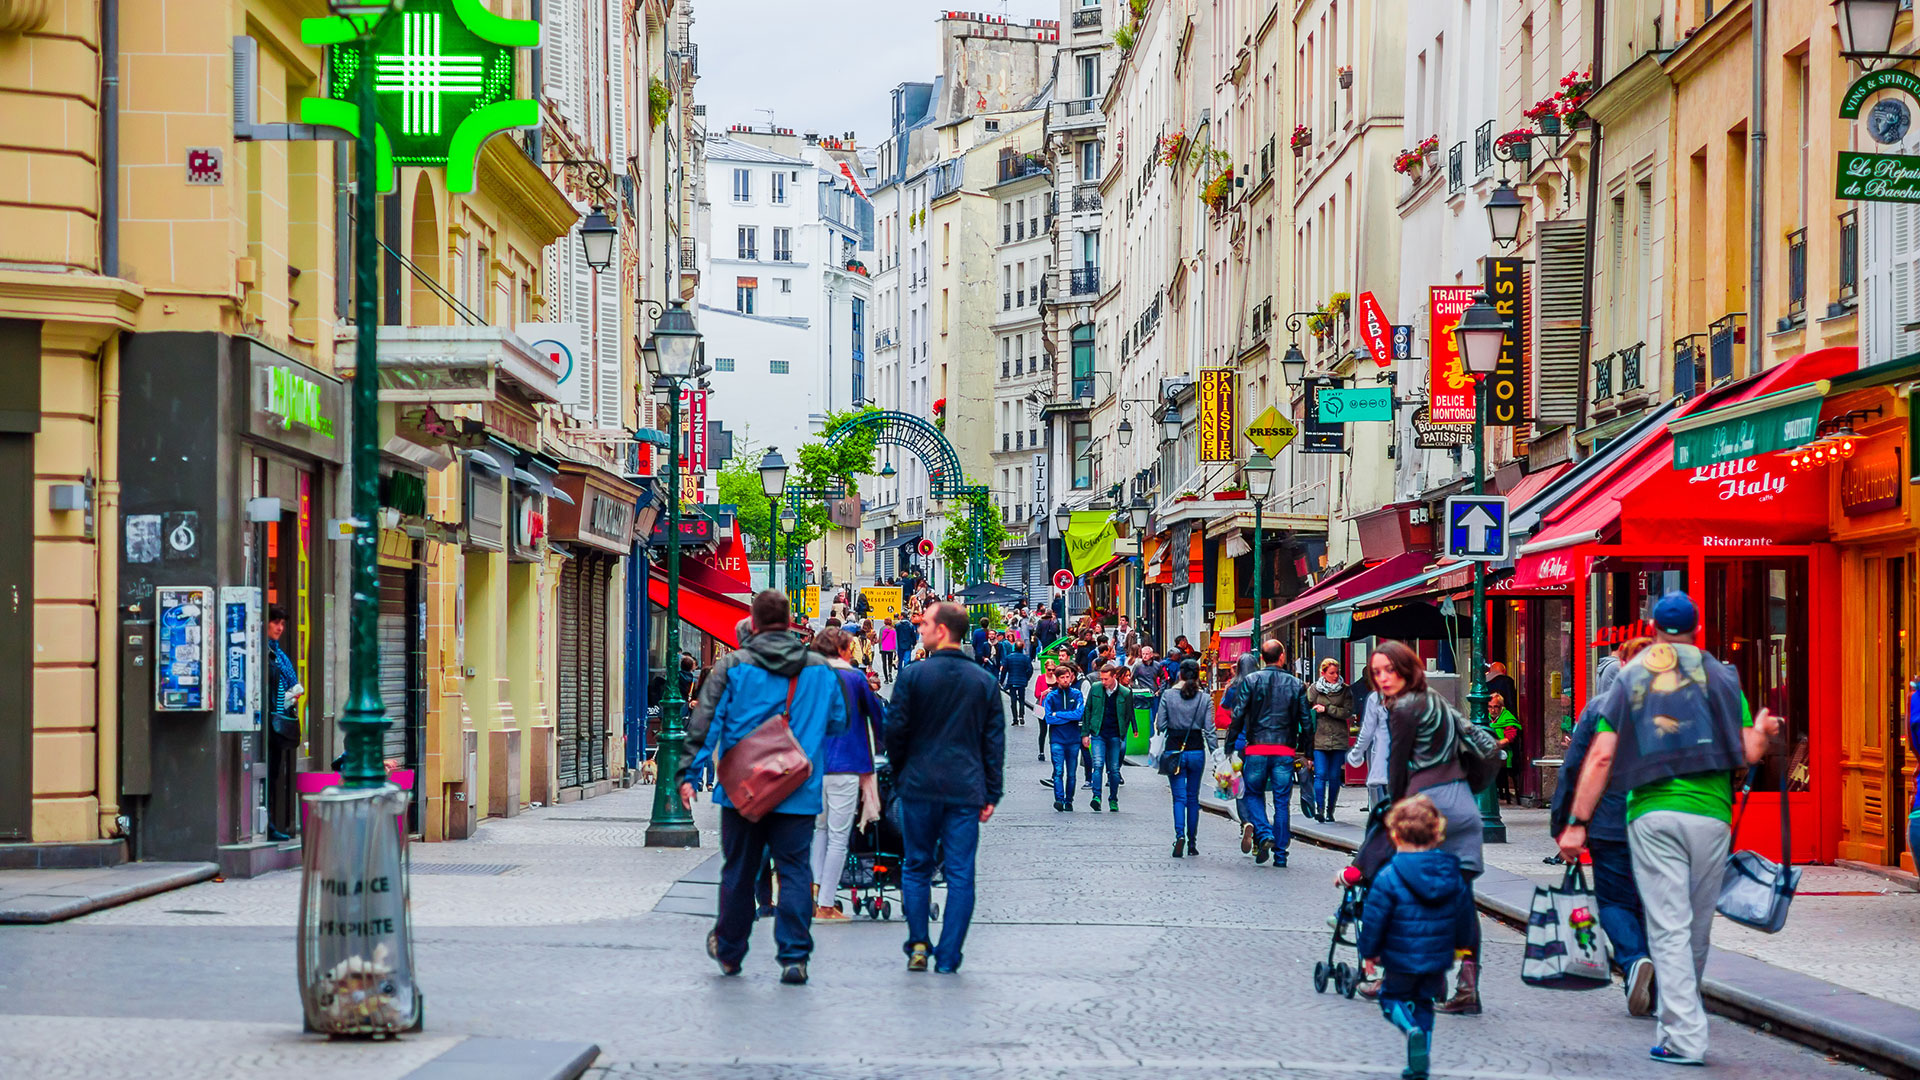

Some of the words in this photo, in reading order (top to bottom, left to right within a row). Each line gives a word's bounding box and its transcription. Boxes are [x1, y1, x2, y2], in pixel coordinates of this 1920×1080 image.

[1846, 86, 1866, 110] VINS
[1867, 80, 1877, 89] &
[1878, 74, 1920, 98] SPIRITU
[1846, 157, 1871, 177] Le
[1874, 159, 1920, 184] Repai
[1844, 181, 1861, 195] de
[1432, 289, 1485, 301] TRAITEU
[1364, 299, 1387, 360] TABAC
[1436, 395, 1465, 407] DELICE
[1202, 372, 1215, 460] BOULANGER
[1219, 372, 1232, 460] PATISSIER
[1432, 407, 1476, 420] MONTORGU
[693, 392, 705, 474] PIZZERIA
[1249, 427, 1294, 437] PRESSE
[1418, 421, 1473, 433] BOULANGER
[1422, 431, 1473, 444] PATISSIER
[1689, 458, 1759, 484] Little
[1036, 456, 1046, 515] LILLA
[1718, 472, 1789, 500] Italy
[696, 520, 707, 536] 3
[1703, 535, 1773, 546] Ristorante
